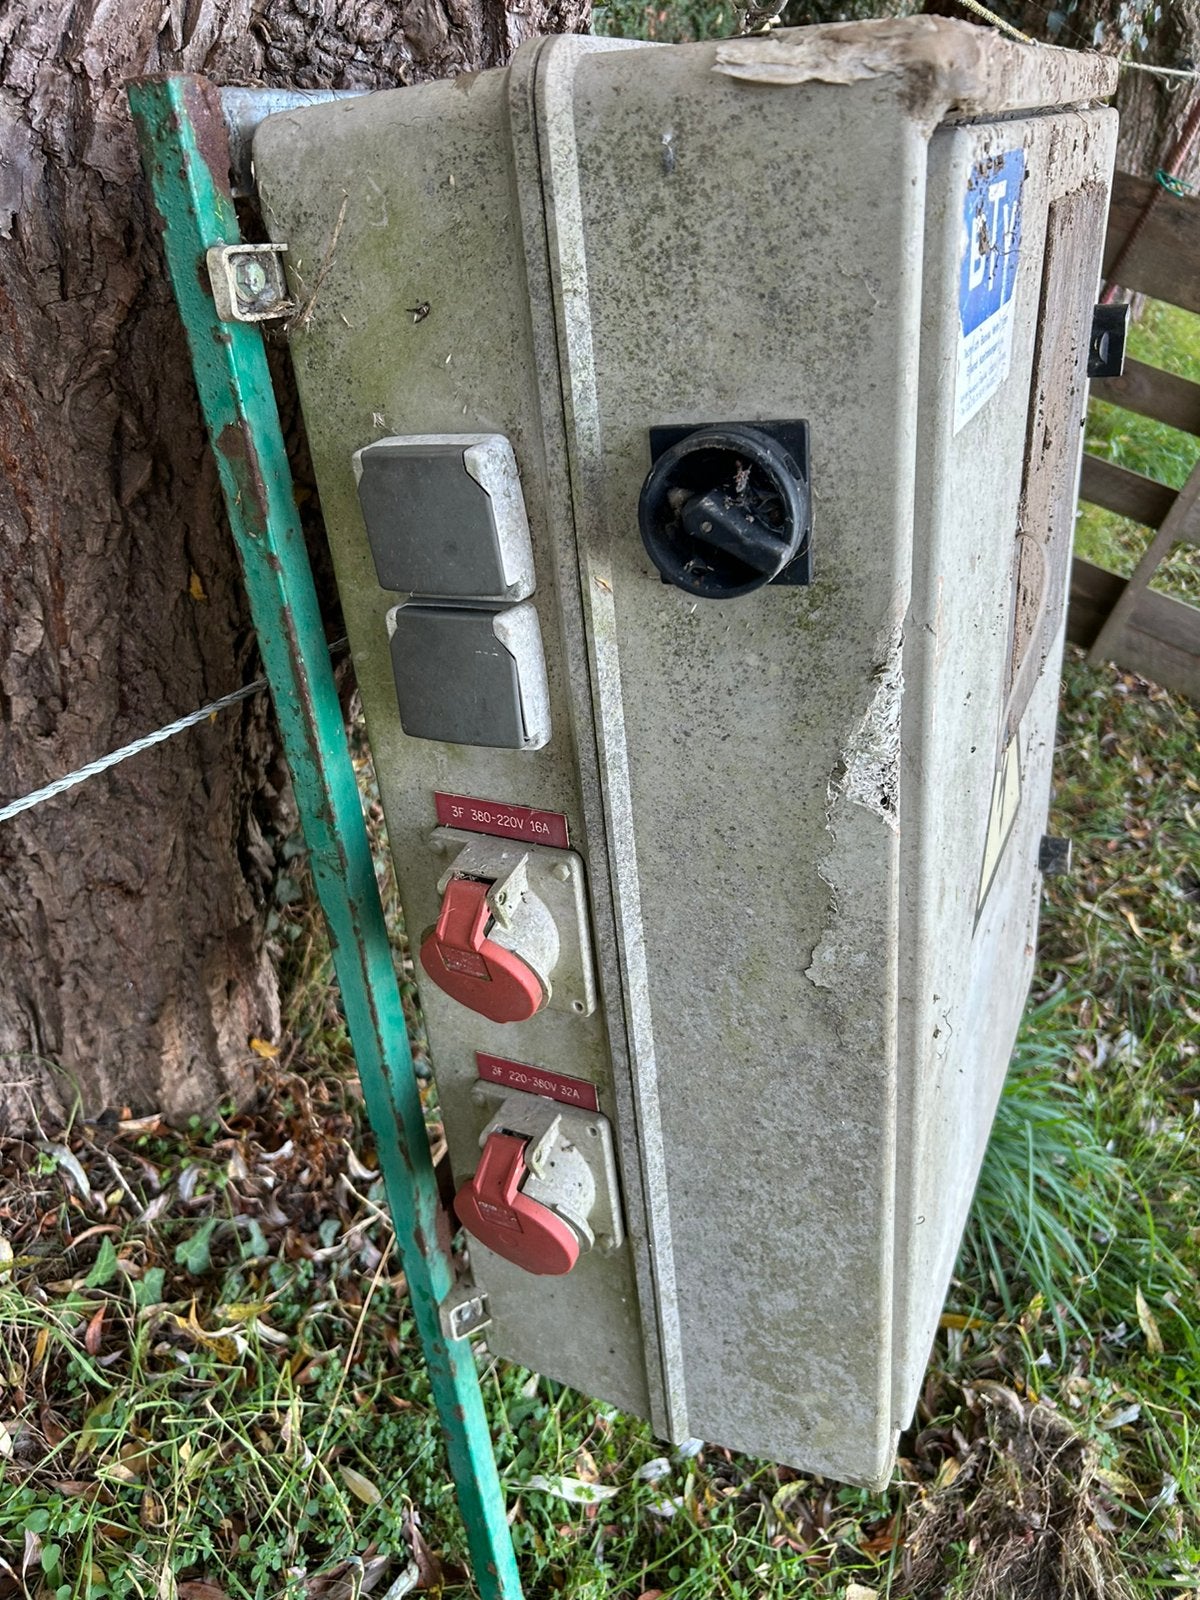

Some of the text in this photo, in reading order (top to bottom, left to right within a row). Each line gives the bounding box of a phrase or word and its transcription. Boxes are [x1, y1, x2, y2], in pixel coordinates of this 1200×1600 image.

[451, 805, 550, 835] 3F 380-220V 16A
[491, 1065, 580, 1099] 3F 220-380V 32A
